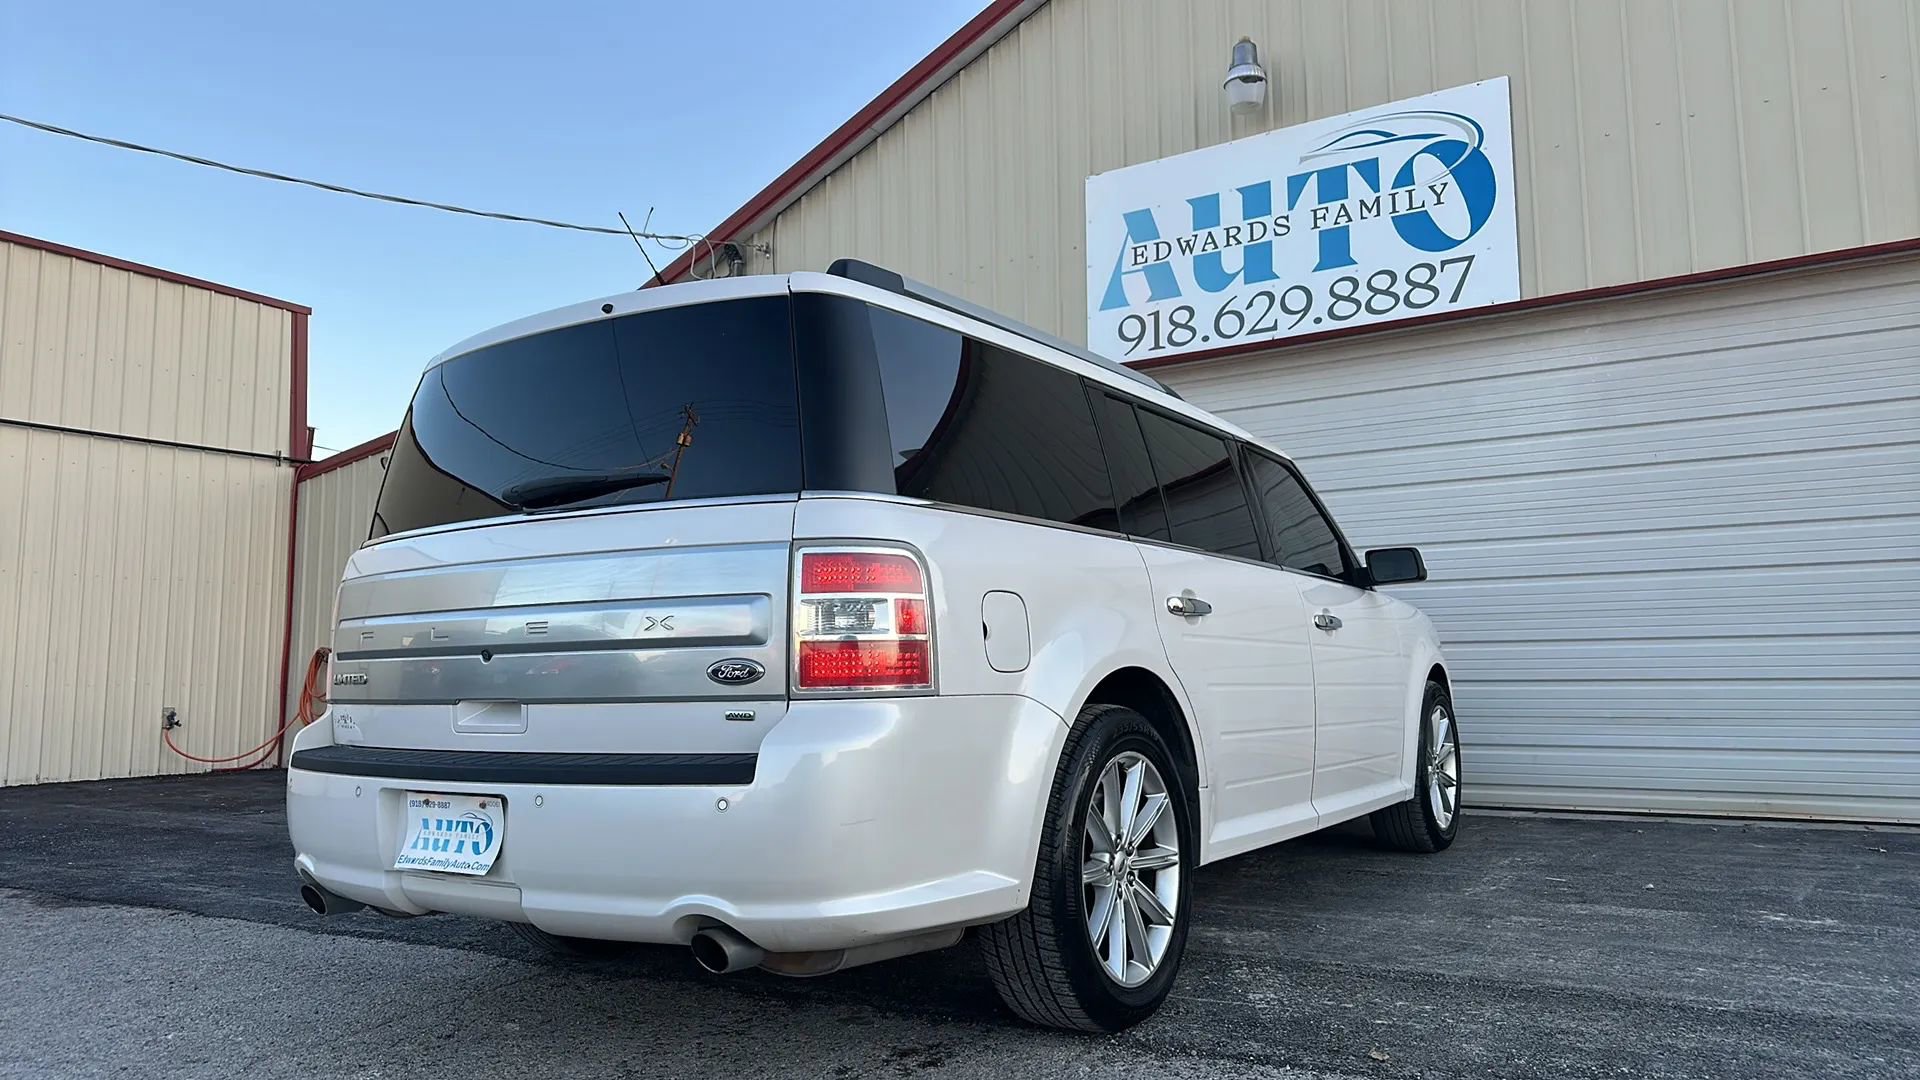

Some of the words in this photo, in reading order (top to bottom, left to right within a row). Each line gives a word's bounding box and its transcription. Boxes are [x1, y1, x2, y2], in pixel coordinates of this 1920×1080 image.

[1099, 138, 1497, 311] AUTO
[1131, 214, 1291, 266] EDWARDS
[1310, 182, 1449, 230] FAMILY
[1118, 254, 1475, 356] 918.629.8887
[360, 615, 675, 648] FLEX
[726, 711, 754, 721] AWD
[411, 818, 493, 856] AUTO
